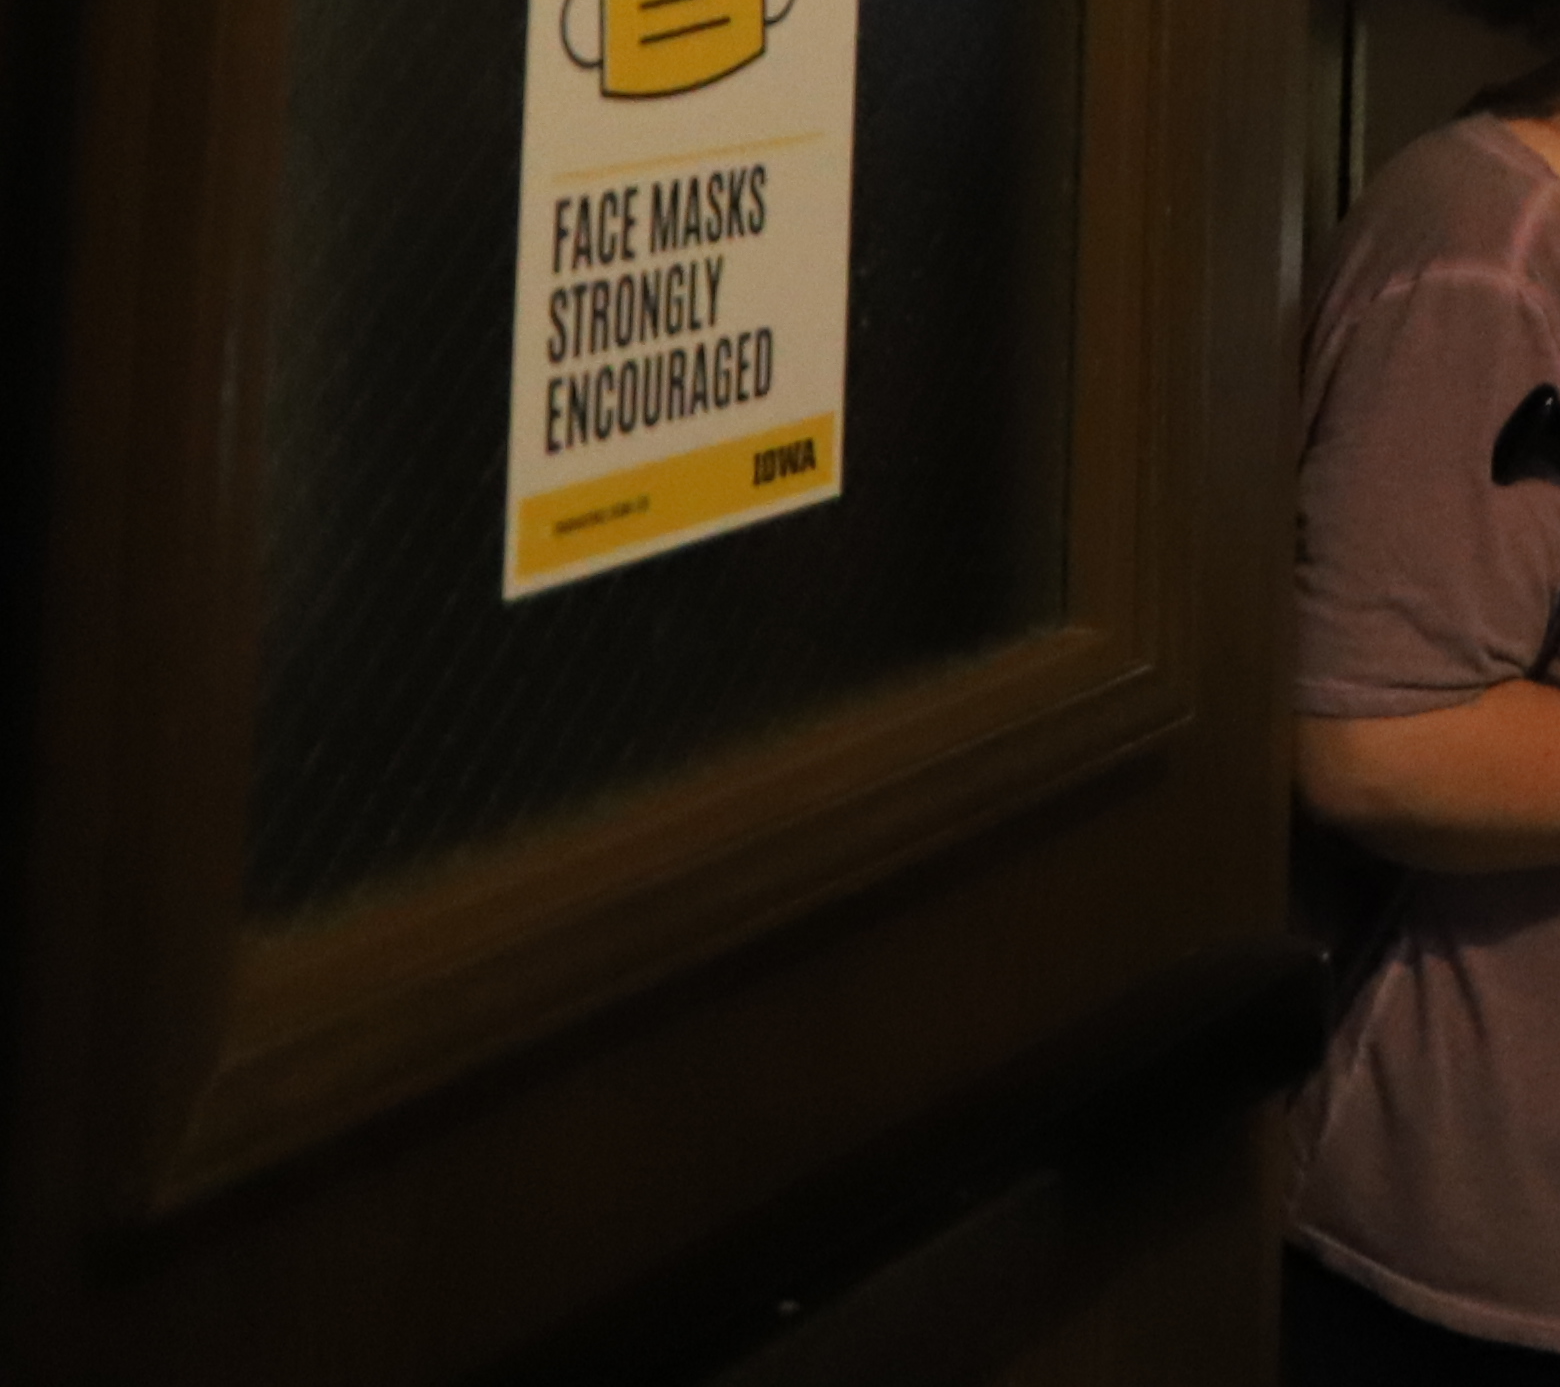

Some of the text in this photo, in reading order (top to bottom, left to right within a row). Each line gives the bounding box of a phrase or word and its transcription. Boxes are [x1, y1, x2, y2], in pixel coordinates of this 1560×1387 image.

[553, 163, 767, 273] FACE MASKS
[547, 254, 724, 363] STRONGLY
[545, 327, 774, 454] ENCOURAGED
[752, 437, 817, 486] IOWA
